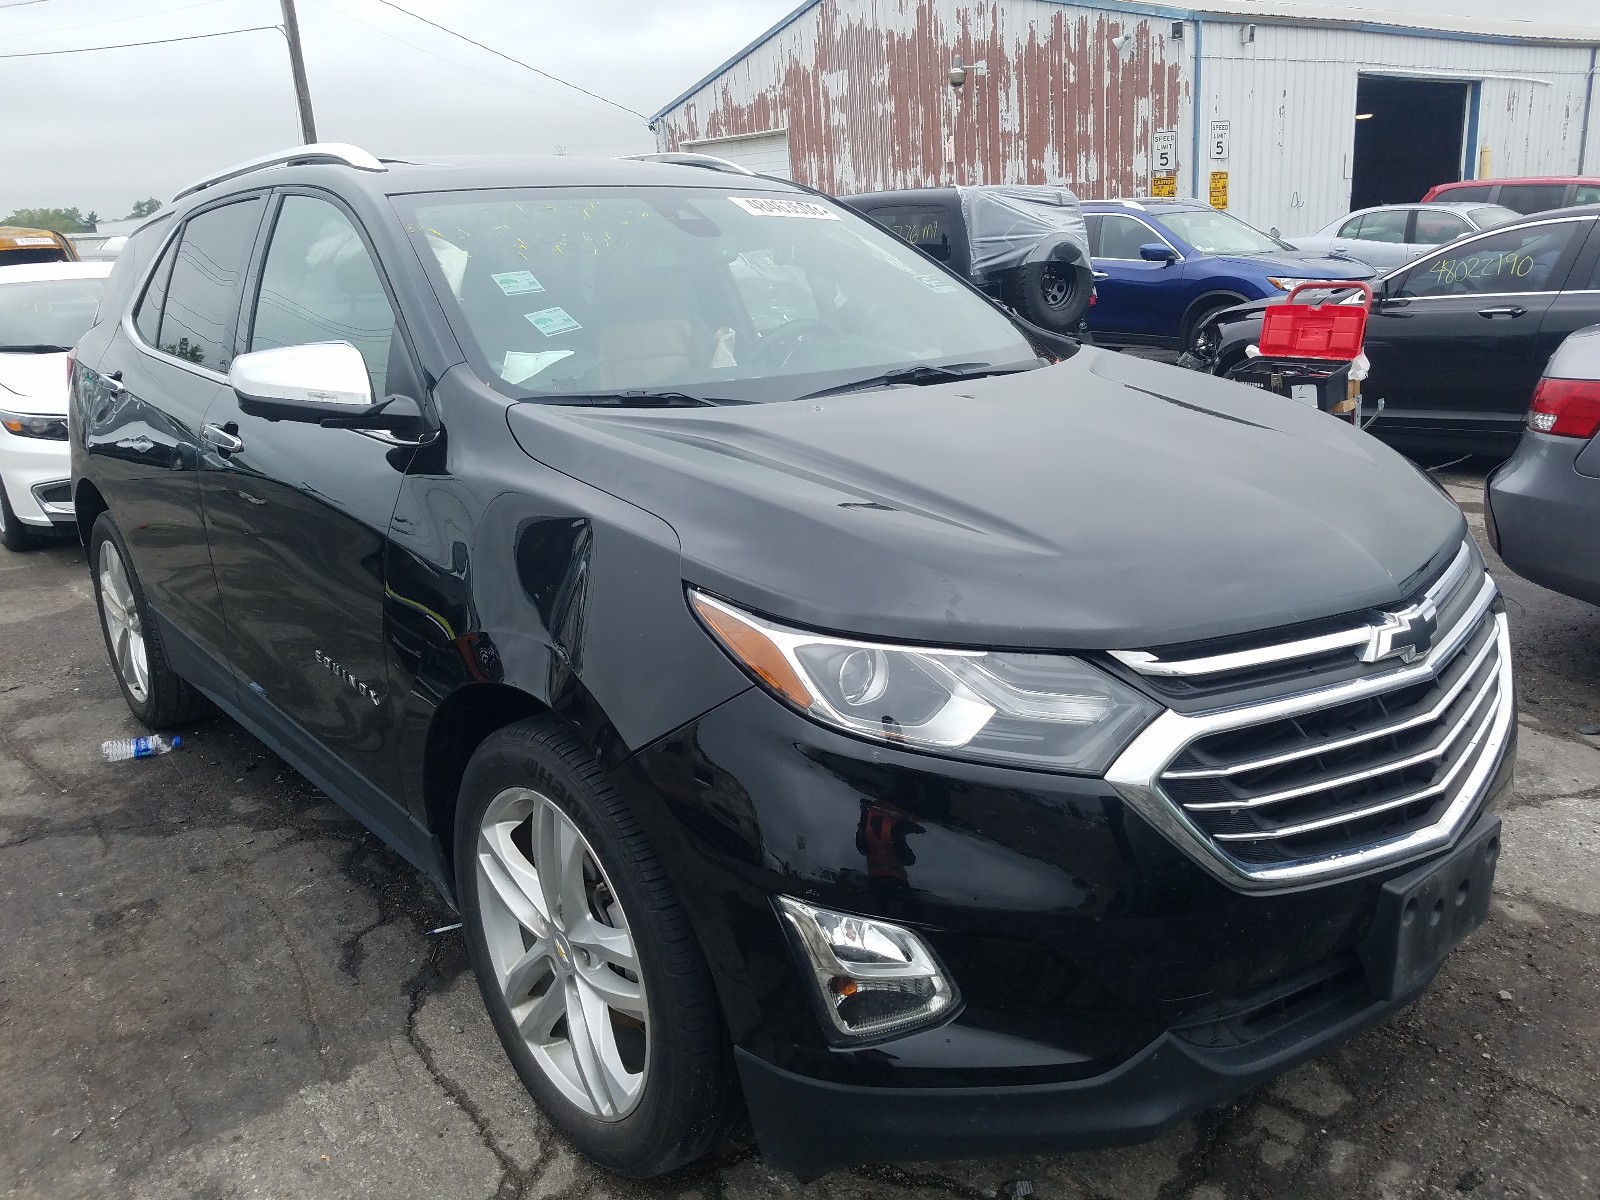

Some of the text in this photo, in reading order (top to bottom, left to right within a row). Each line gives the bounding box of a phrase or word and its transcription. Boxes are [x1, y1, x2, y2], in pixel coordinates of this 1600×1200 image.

[1154, 134, 1175, 143] SPEED
[1156, 143, 1173, 151] LIMIT
[1215, 141, 1224, 155] 5
[1159, 152, 1169, 167] 5
[1429, 253, 1534, 284] 48022190
[315, 649, 381, 706] EQUINOX
